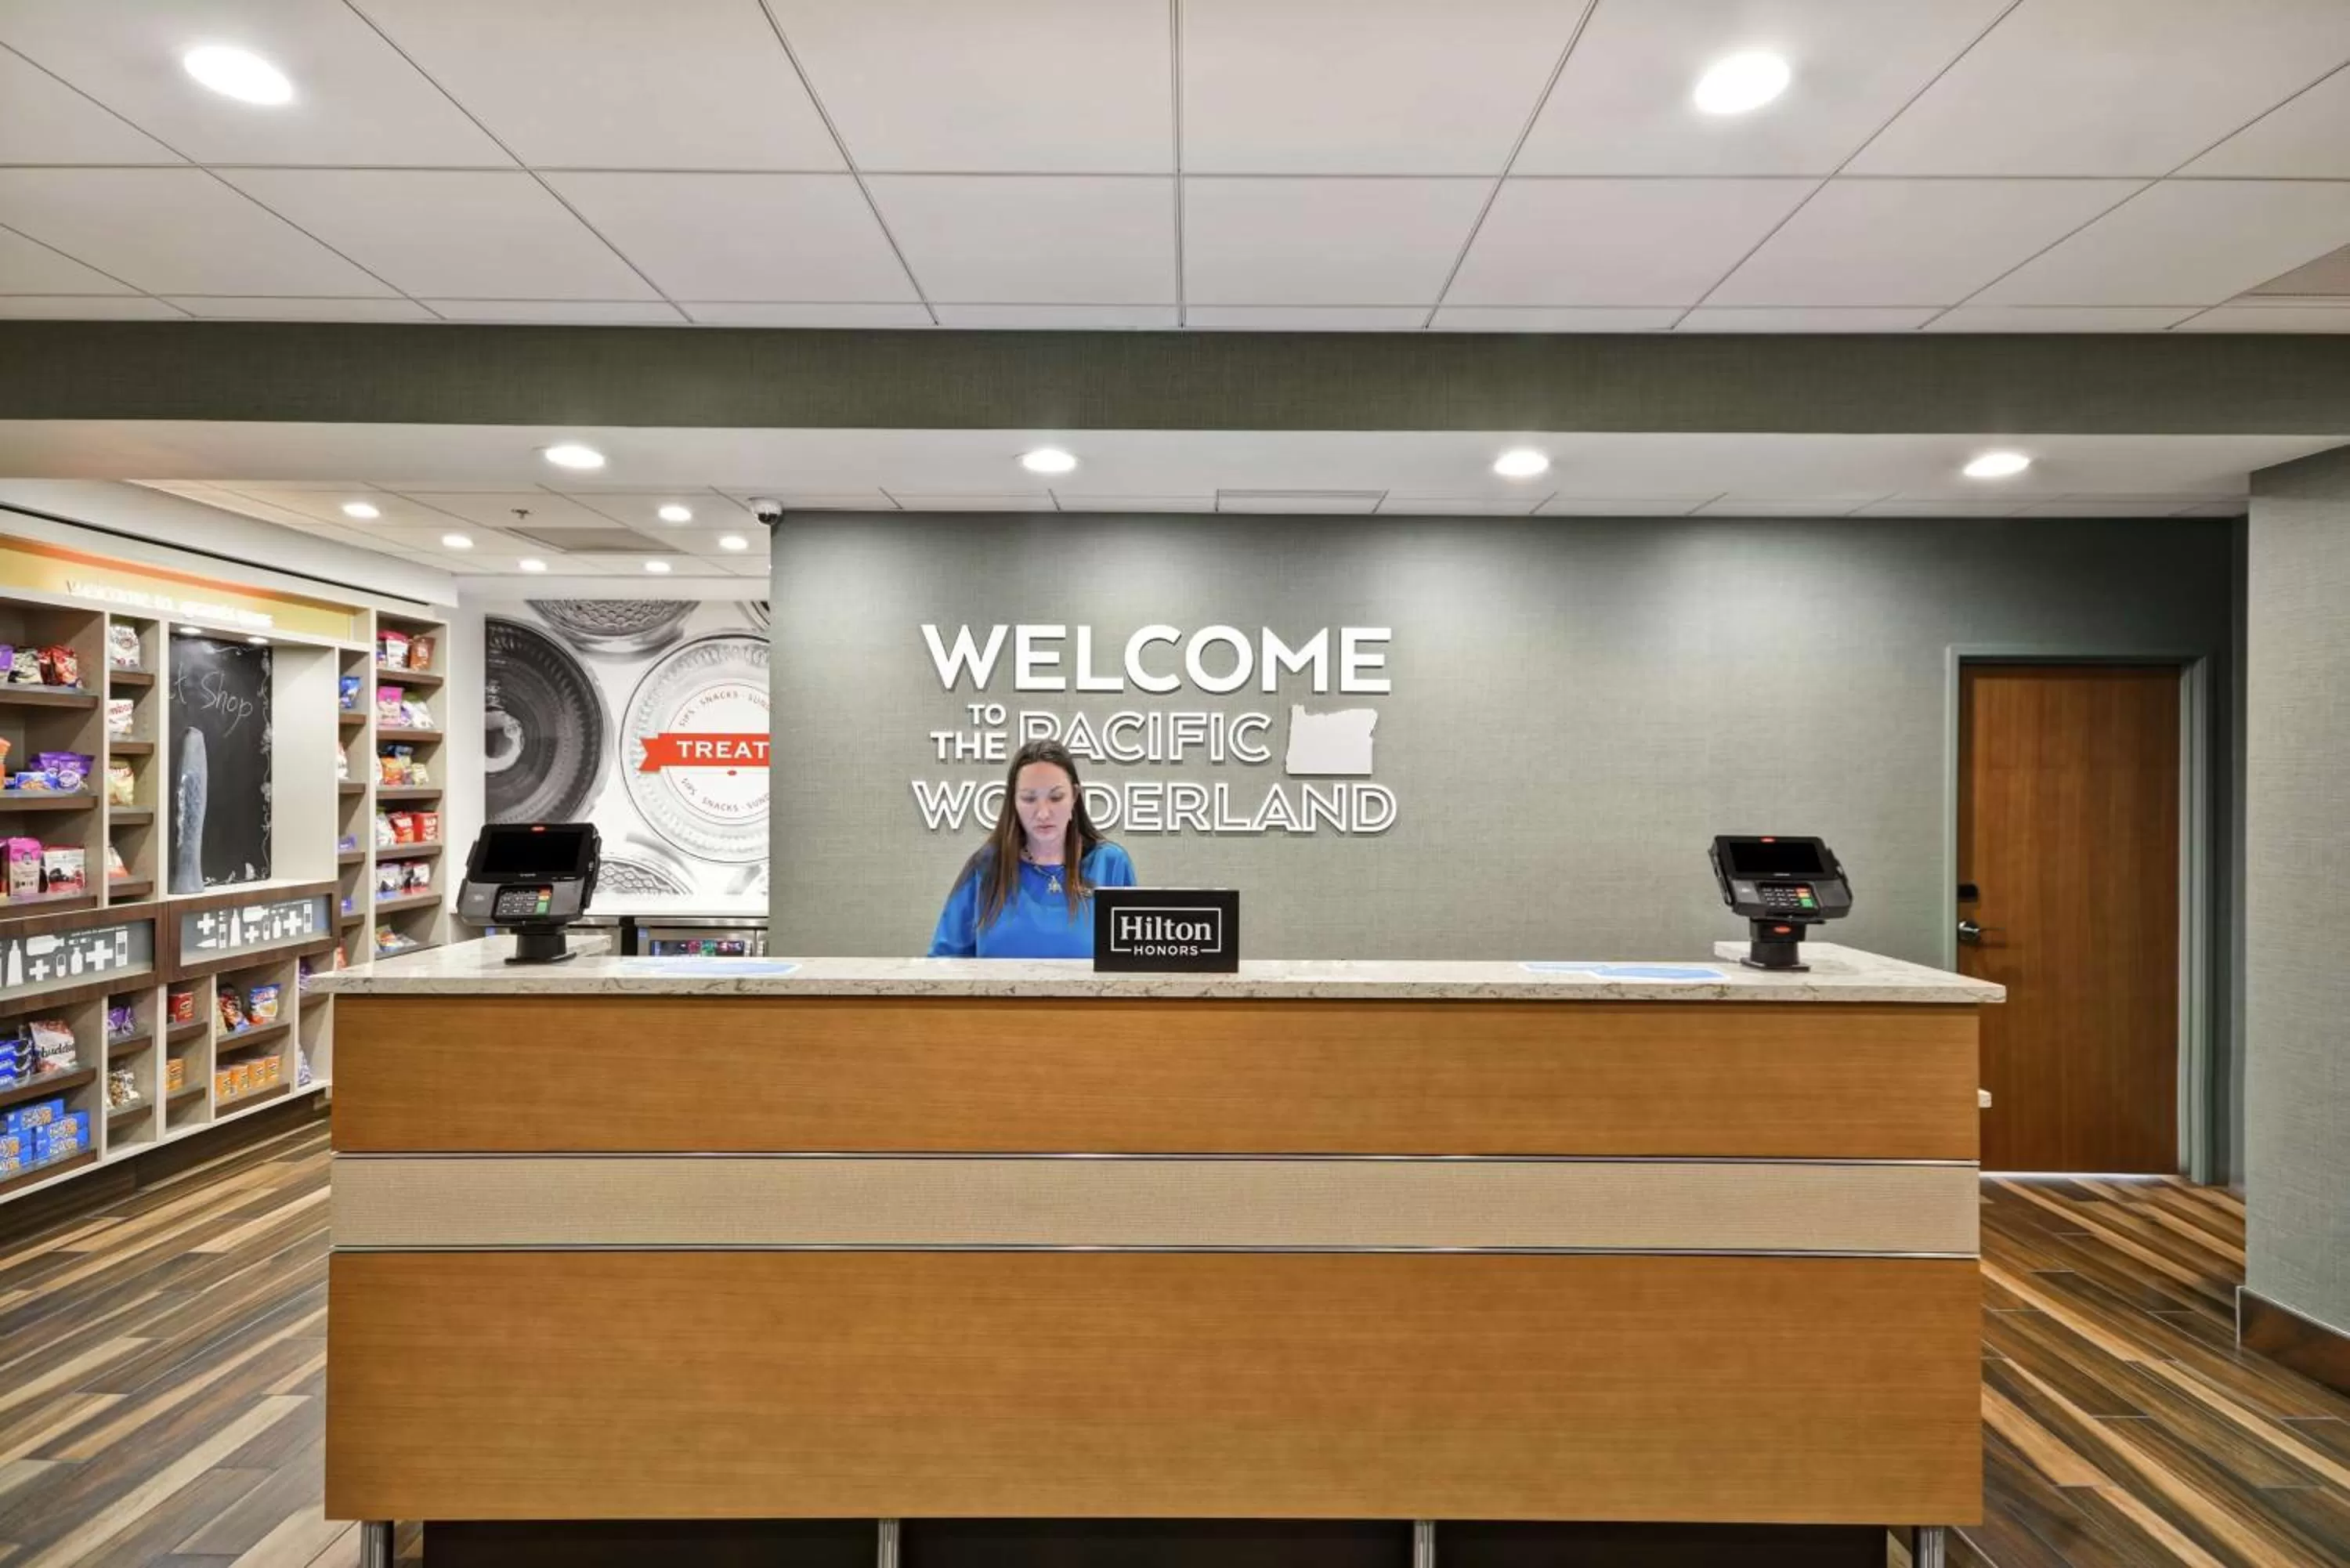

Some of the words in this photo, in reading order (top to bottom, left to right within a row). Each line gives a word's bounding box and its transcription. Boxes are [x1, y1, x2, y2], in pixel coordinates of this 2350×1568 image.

[920, 624, 1392, 693] WELCOME
[201, 670, 253, 738] Shop
[967, 704, 1007, 725] TO
[676, 740, 770, 759] TREAT
[930, 732, 1008, 760] THE
[1019, 711, 1271, 762] PACIFIC
[911, 782, 1397, 833] WODERLAND
[1119, 916, 1212, 941] Hilton
[1133, 945, 1199, 956] HONORS
